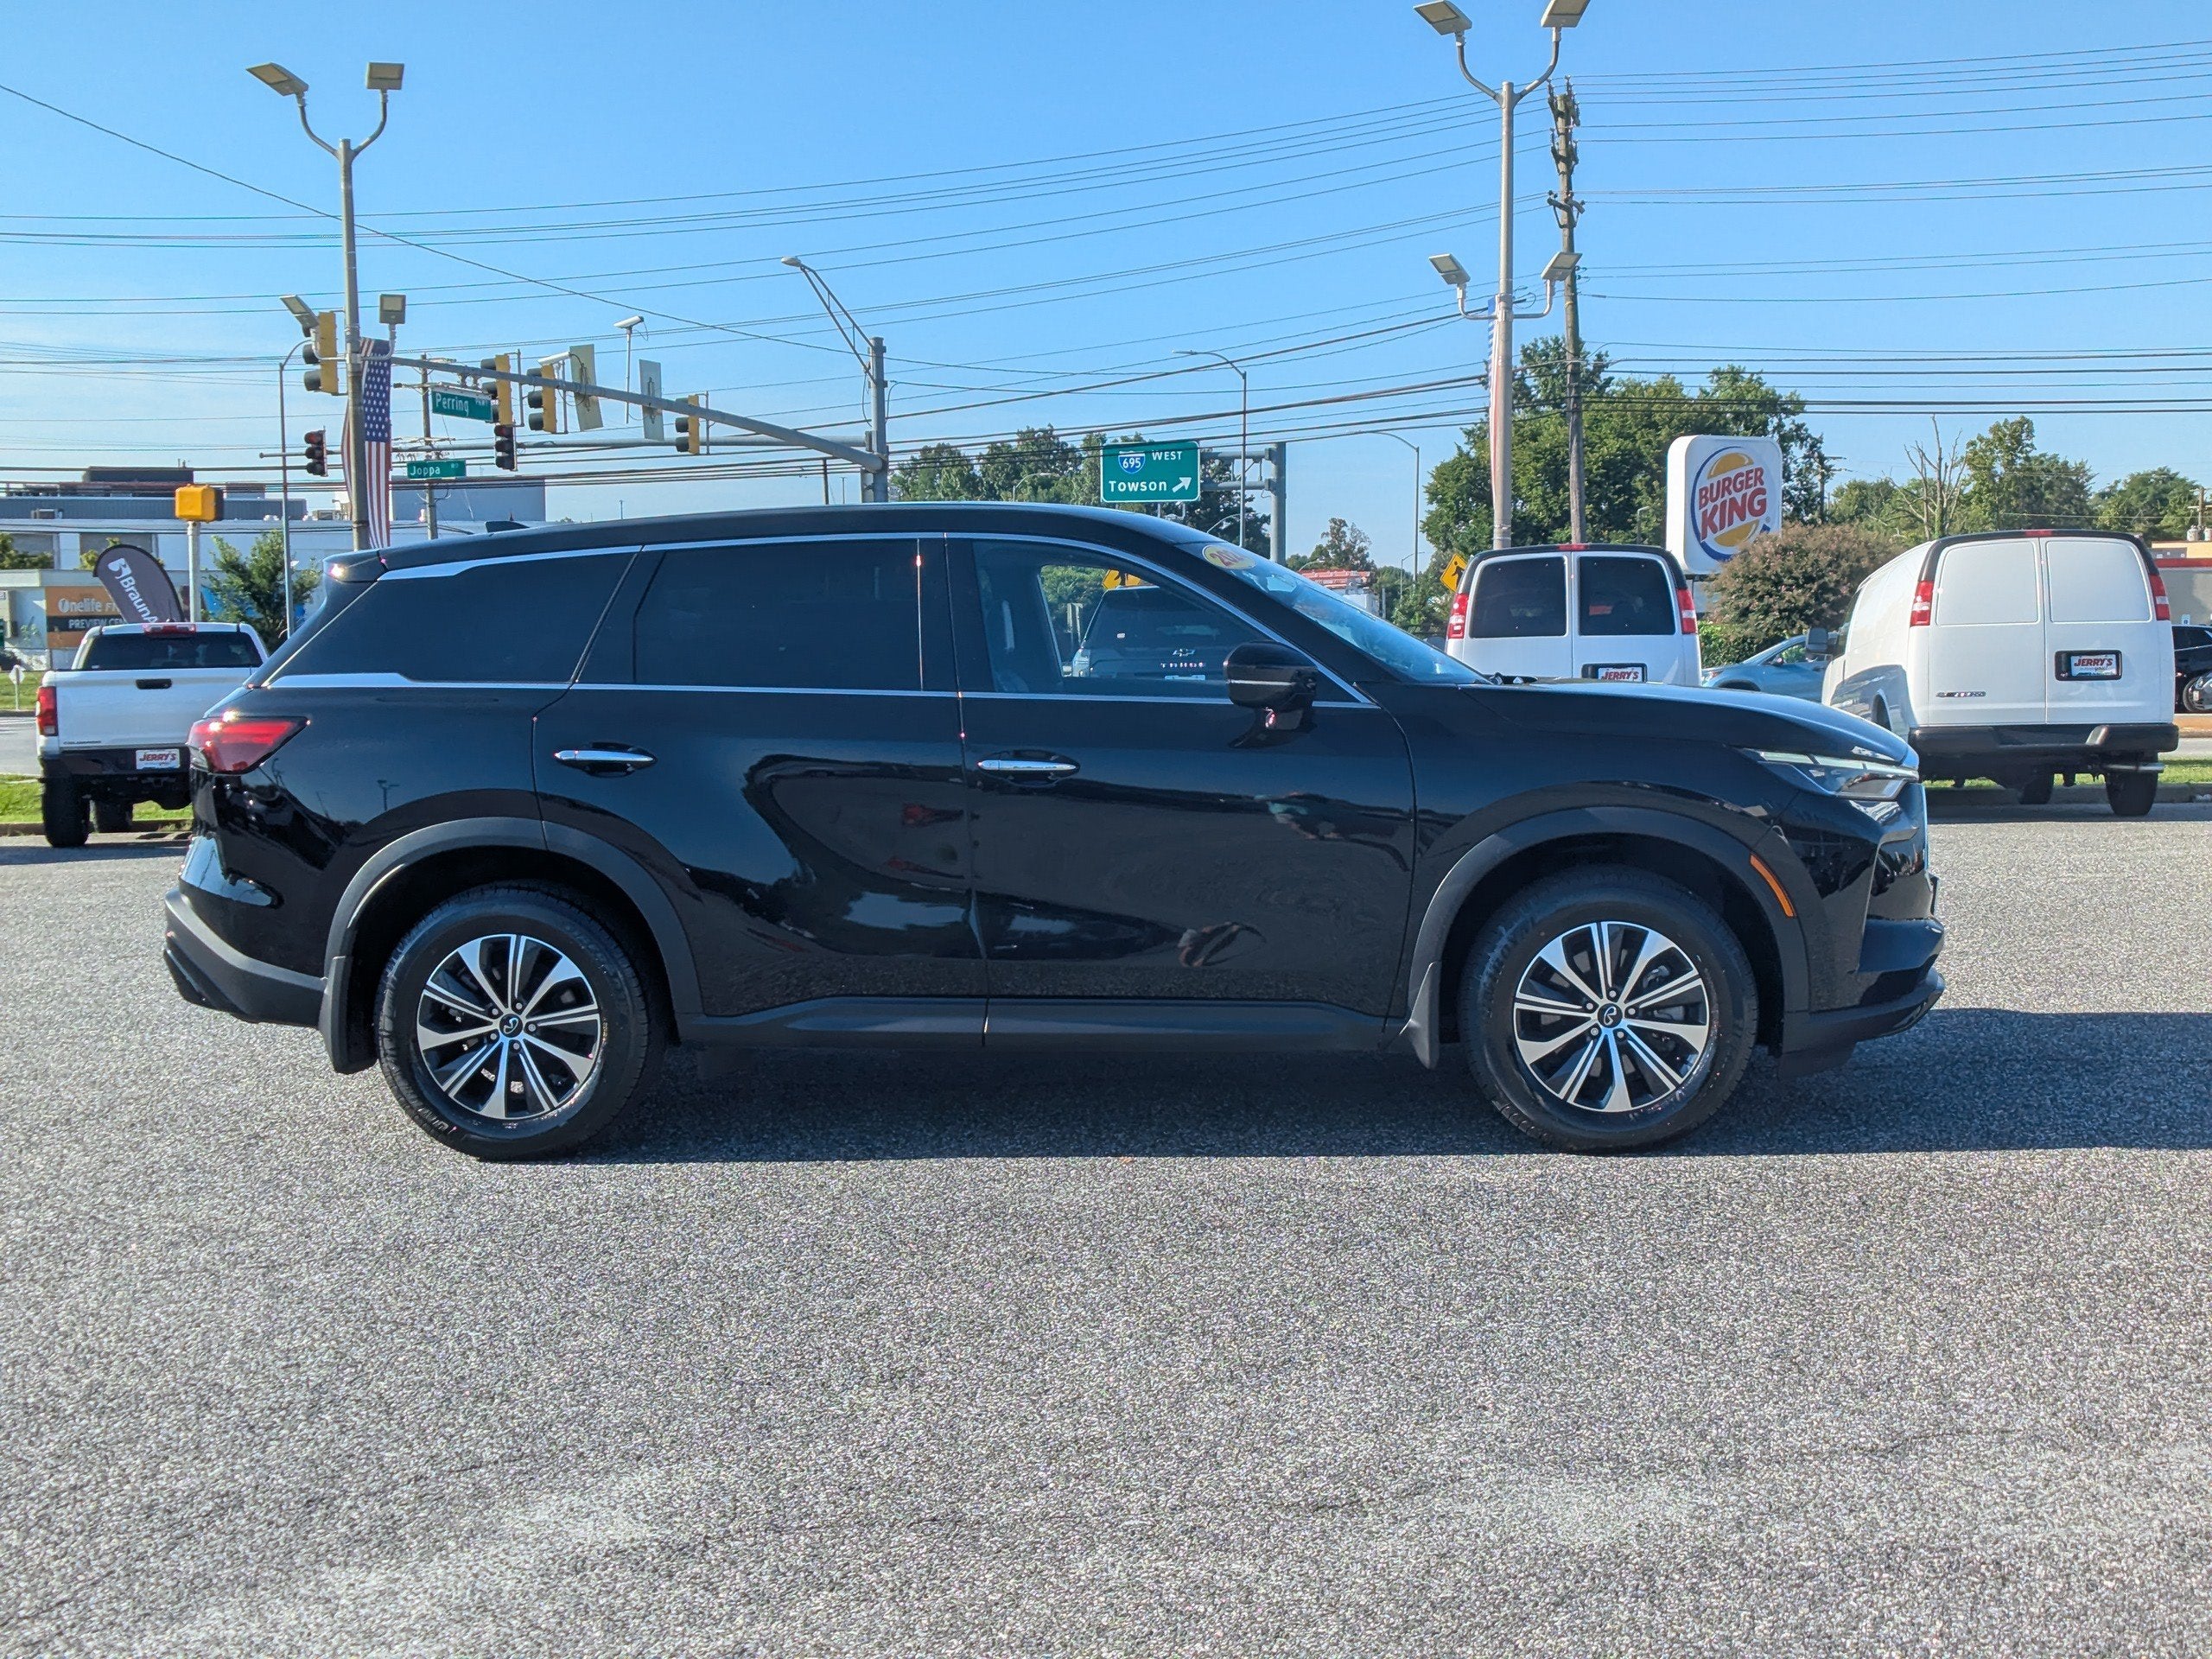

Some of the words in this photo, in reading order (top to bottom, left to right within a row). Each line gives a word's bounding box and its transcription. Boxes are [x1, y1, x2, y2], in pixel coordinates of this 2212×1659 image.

[435, 393, 469, 416] Perring
[1122, 457, 1141, 468] 695
[1152, 450, 1183, 461] WEST
[410, 466, 441, 476] Joppa
[1109, 480, 1167, 493] Towson
[1699, 467, 1764, 510] BURGER
[1700, 487, 1767, 541] KING
[2073, 658, 2113, 666] JERRY'S
[1601, 671, 1640, 680] JERRY'S
[139, 753, 178, 761] JERRY'S
